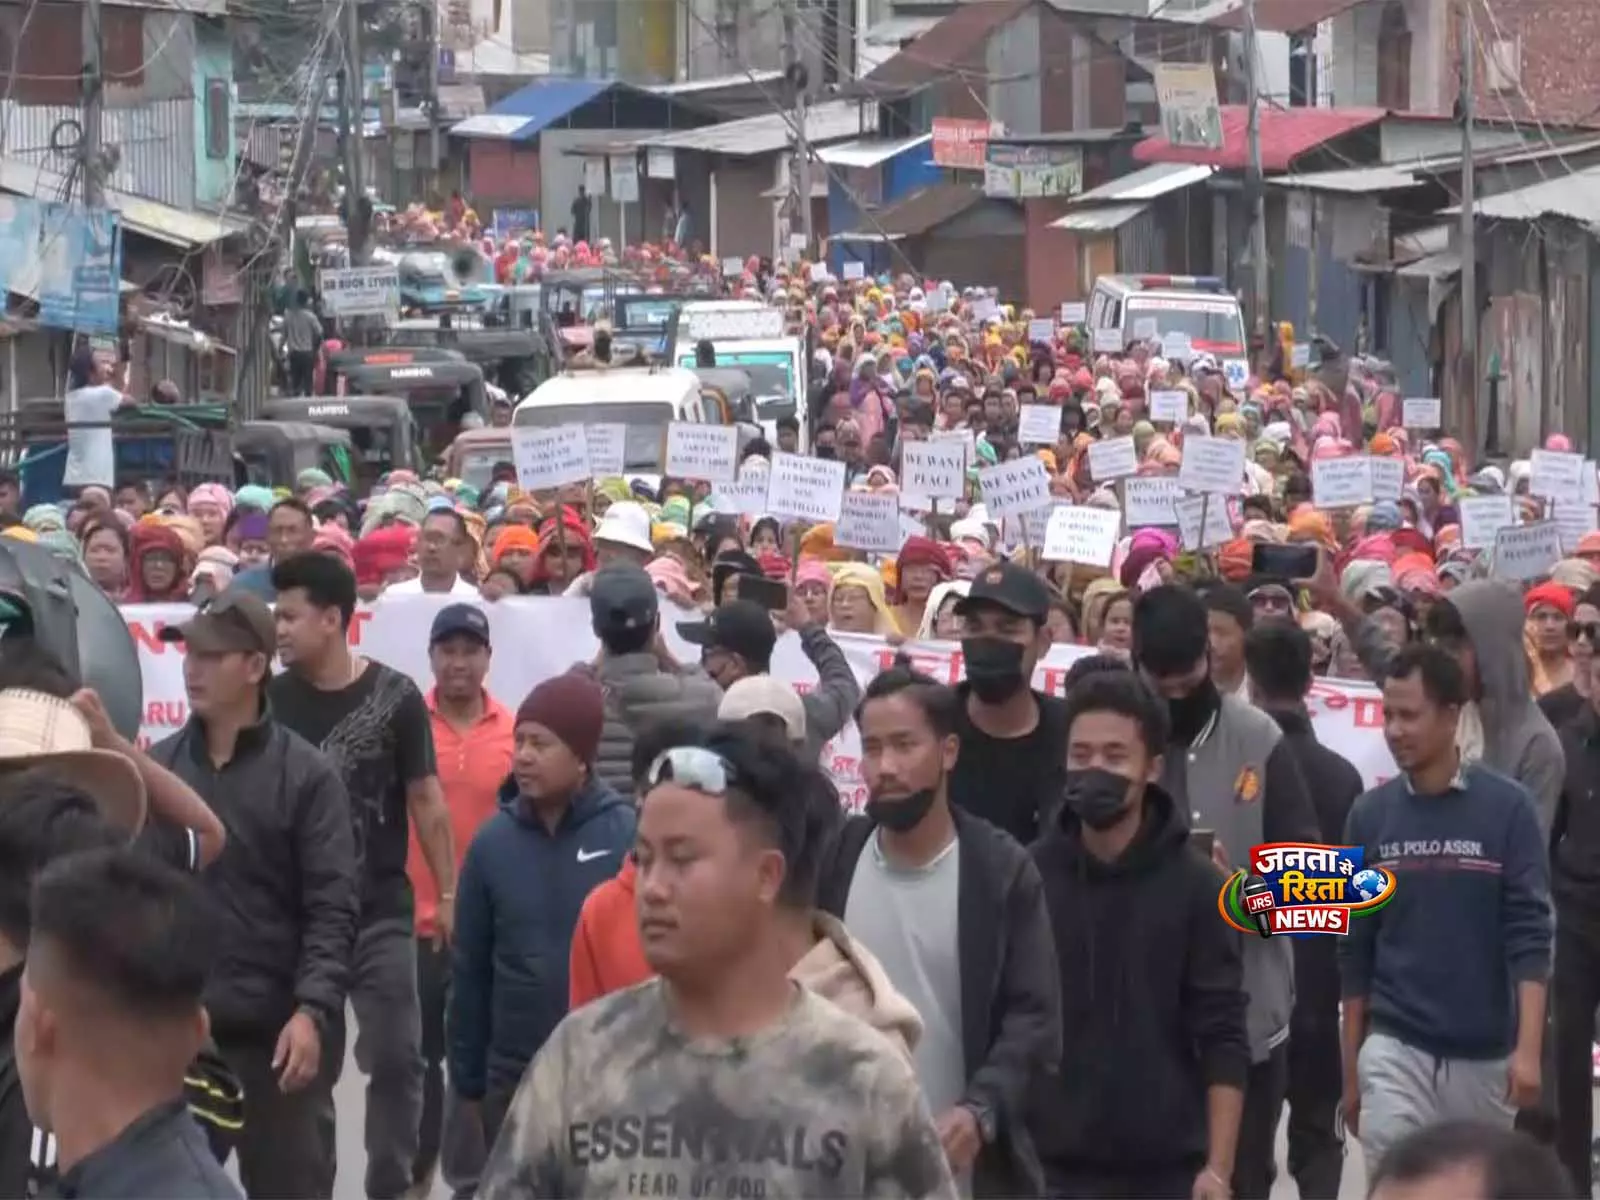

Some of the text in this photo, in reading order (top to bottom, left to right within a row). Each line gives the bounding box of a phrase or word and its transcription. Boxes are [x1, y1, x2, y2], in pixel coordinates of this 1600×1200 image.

[390, 367, 433, 378] NAMBOL
[905, 452, 961, 470] WE WANT
[914, 474, 950, 487] PEACE
[982, 465, 1044, 491] WE WANT
[992, 485, 1041, 508] JUSTICE
[1403, 840, 1440, 855] POLO
[627, 1173, 678, 1197] FEAR
